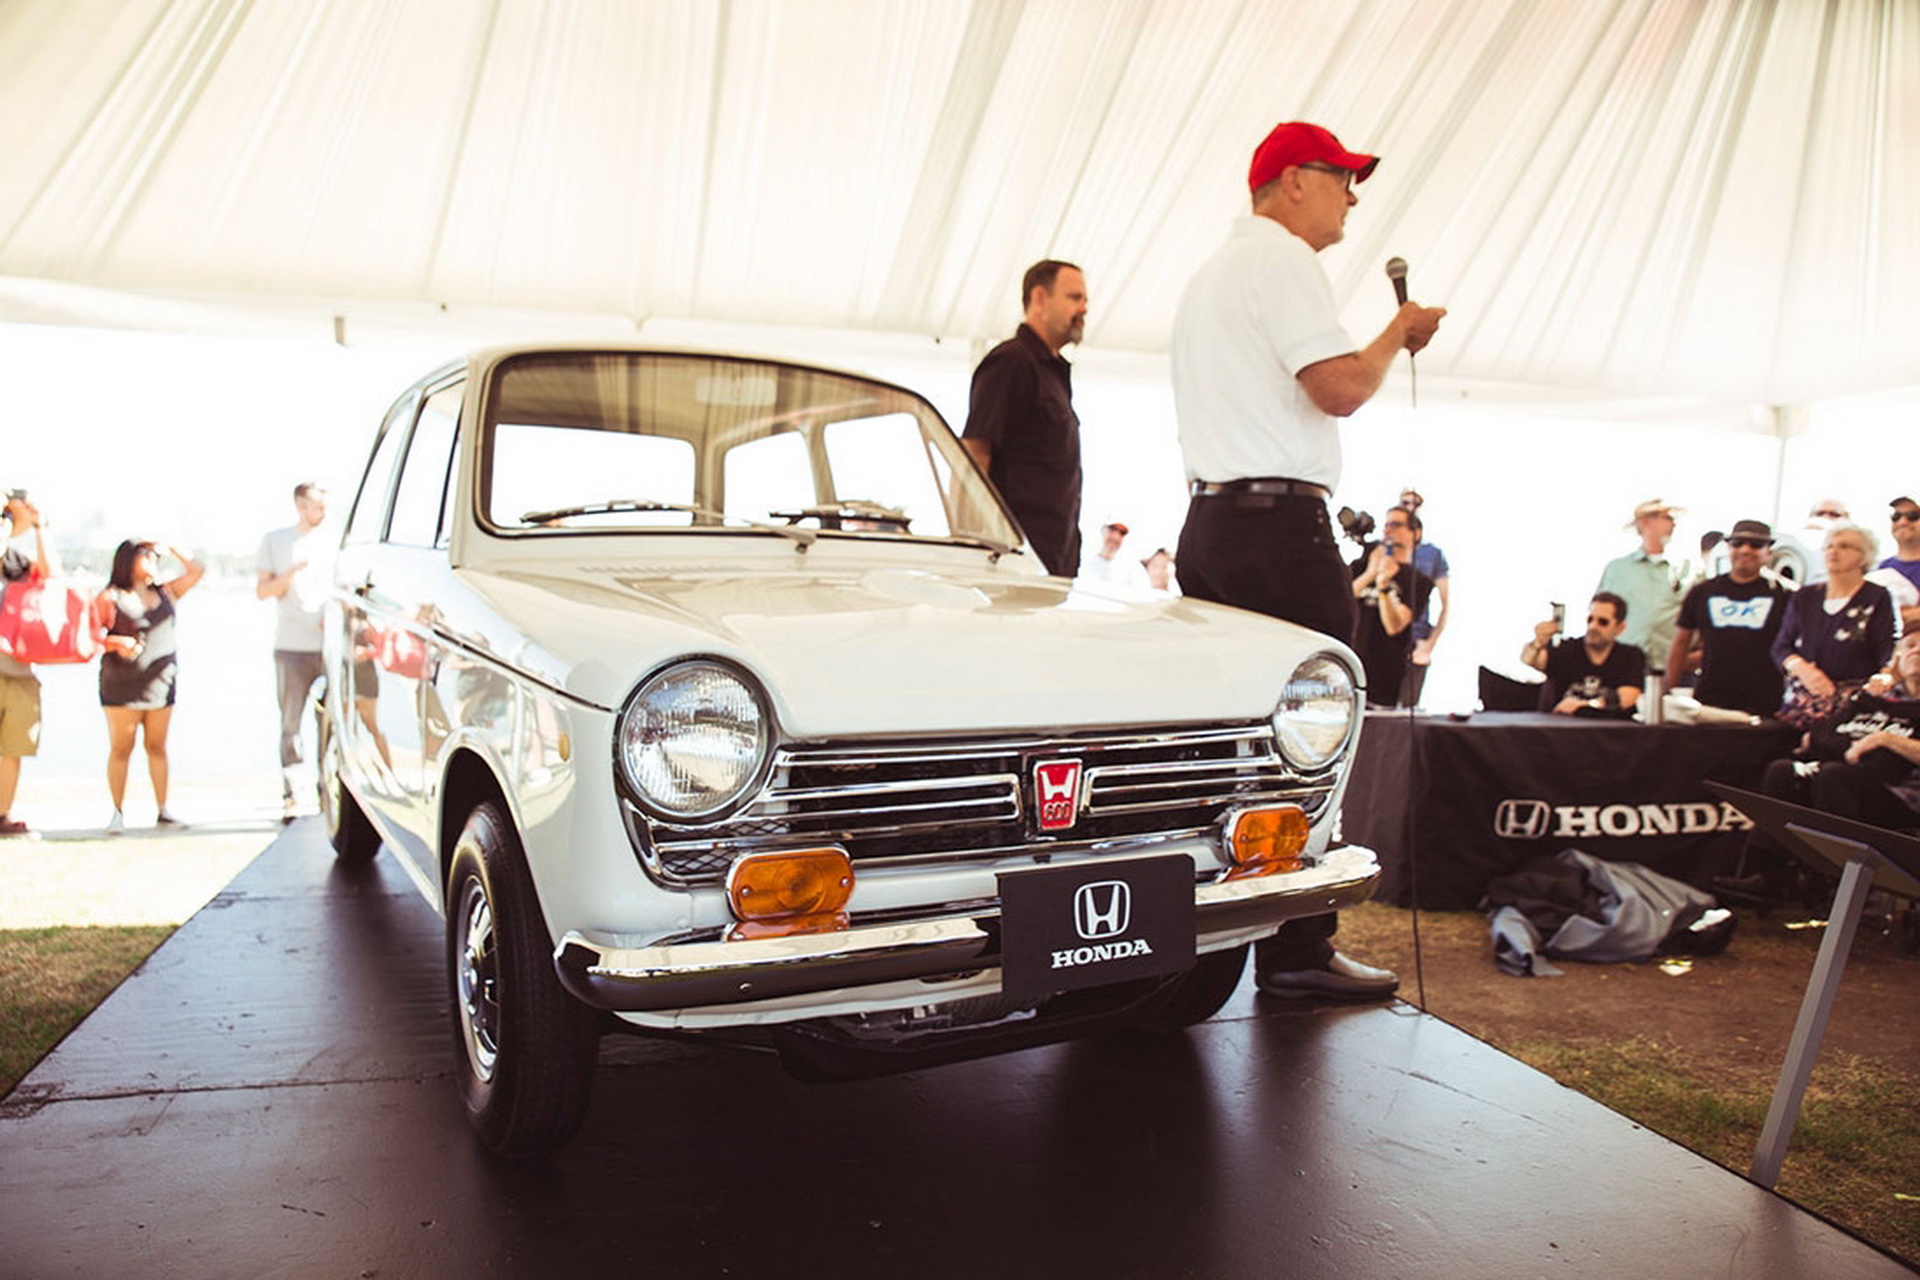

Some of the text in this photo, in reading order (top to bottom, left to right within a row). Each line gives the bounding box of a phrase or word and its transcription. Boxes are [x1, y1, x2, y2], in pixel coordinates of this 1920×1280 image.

[1043, 801, 1072, 820] 600
[1553, 802, 1755, 837] HONDA
[1051, 939, 1153, 969] HONDA
